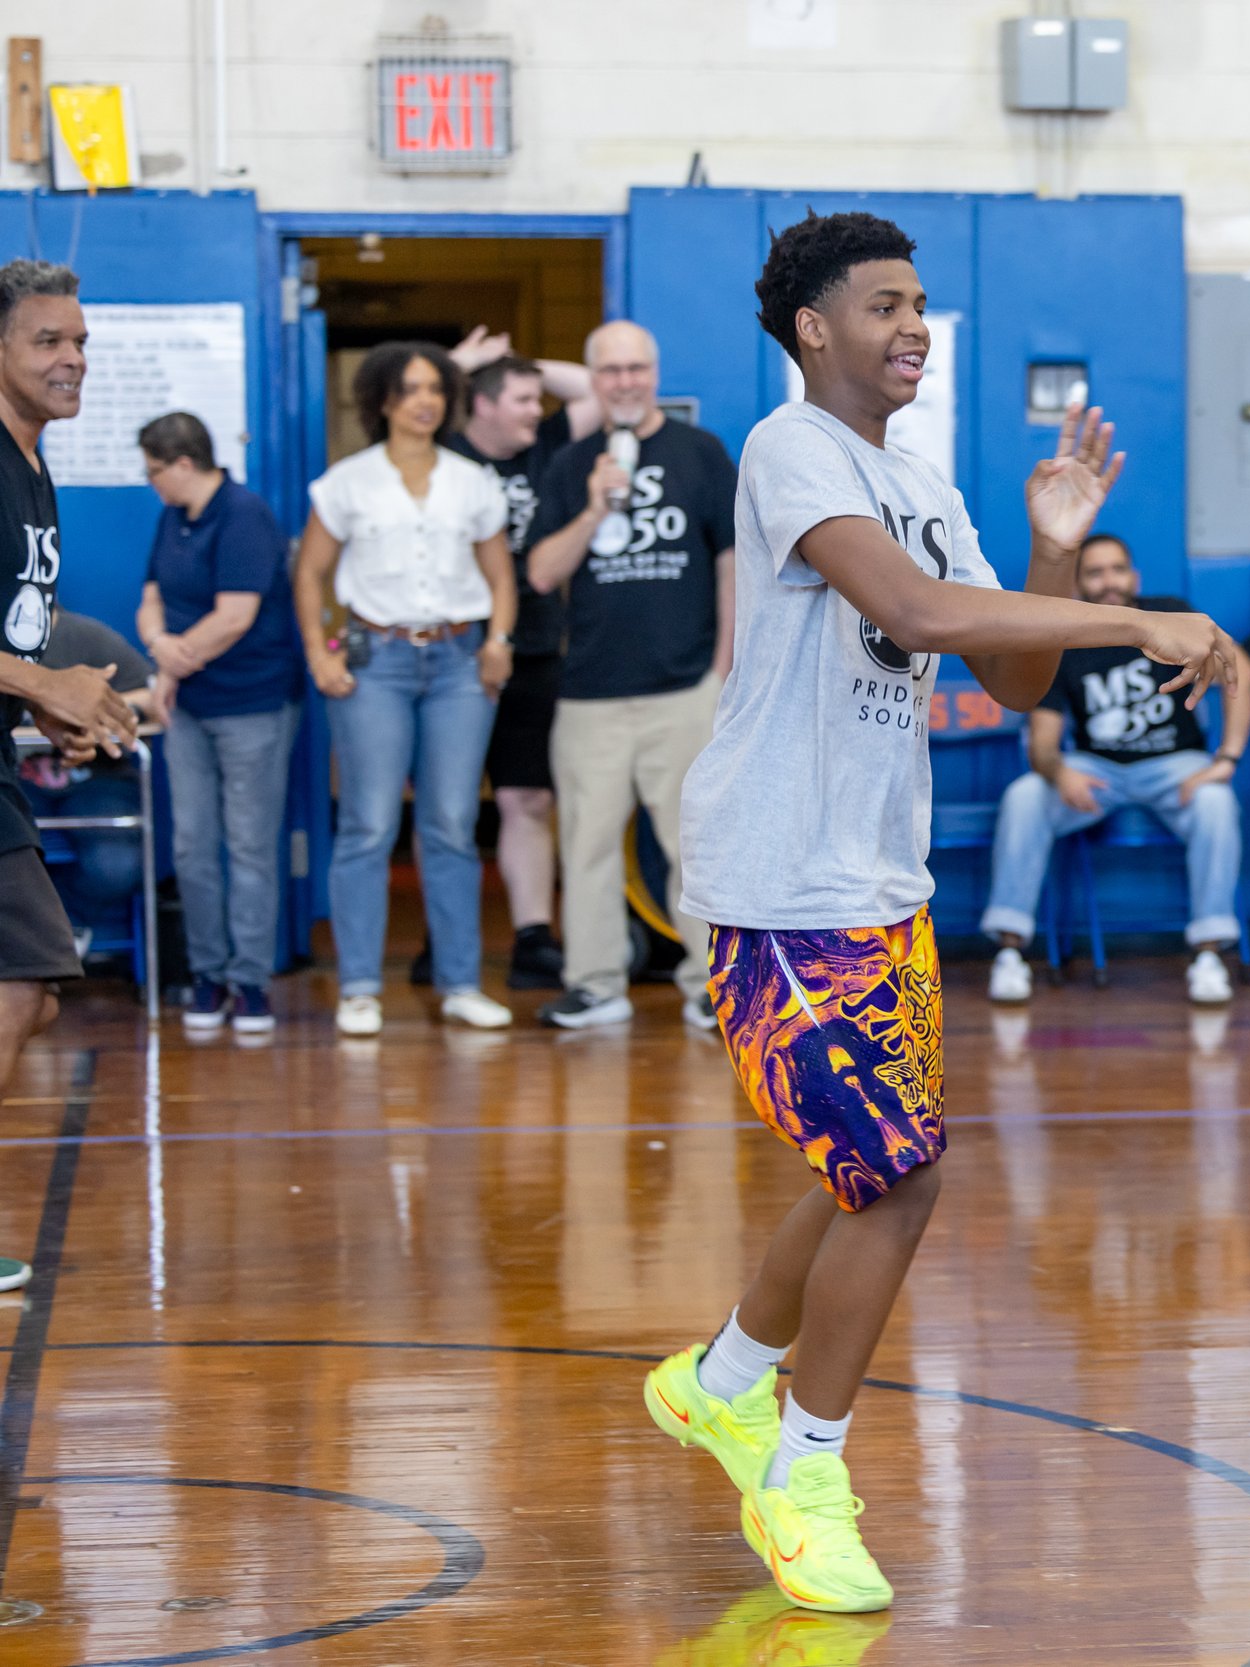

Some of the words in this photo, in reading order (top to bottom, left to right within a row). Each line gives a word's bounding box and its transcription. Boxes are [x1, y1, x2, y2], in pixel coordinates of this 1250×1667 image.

[396, 72, 499, 152] EXIT
[630, 464, 666, 508] S
[627, 505, 688, 554] 50
[852, 677, 908, 704] PRID
[955, 690, 1004, 730] 50
[1082, 656, 1156, 715] MS
[1122, 693, 1175, 743] 50
